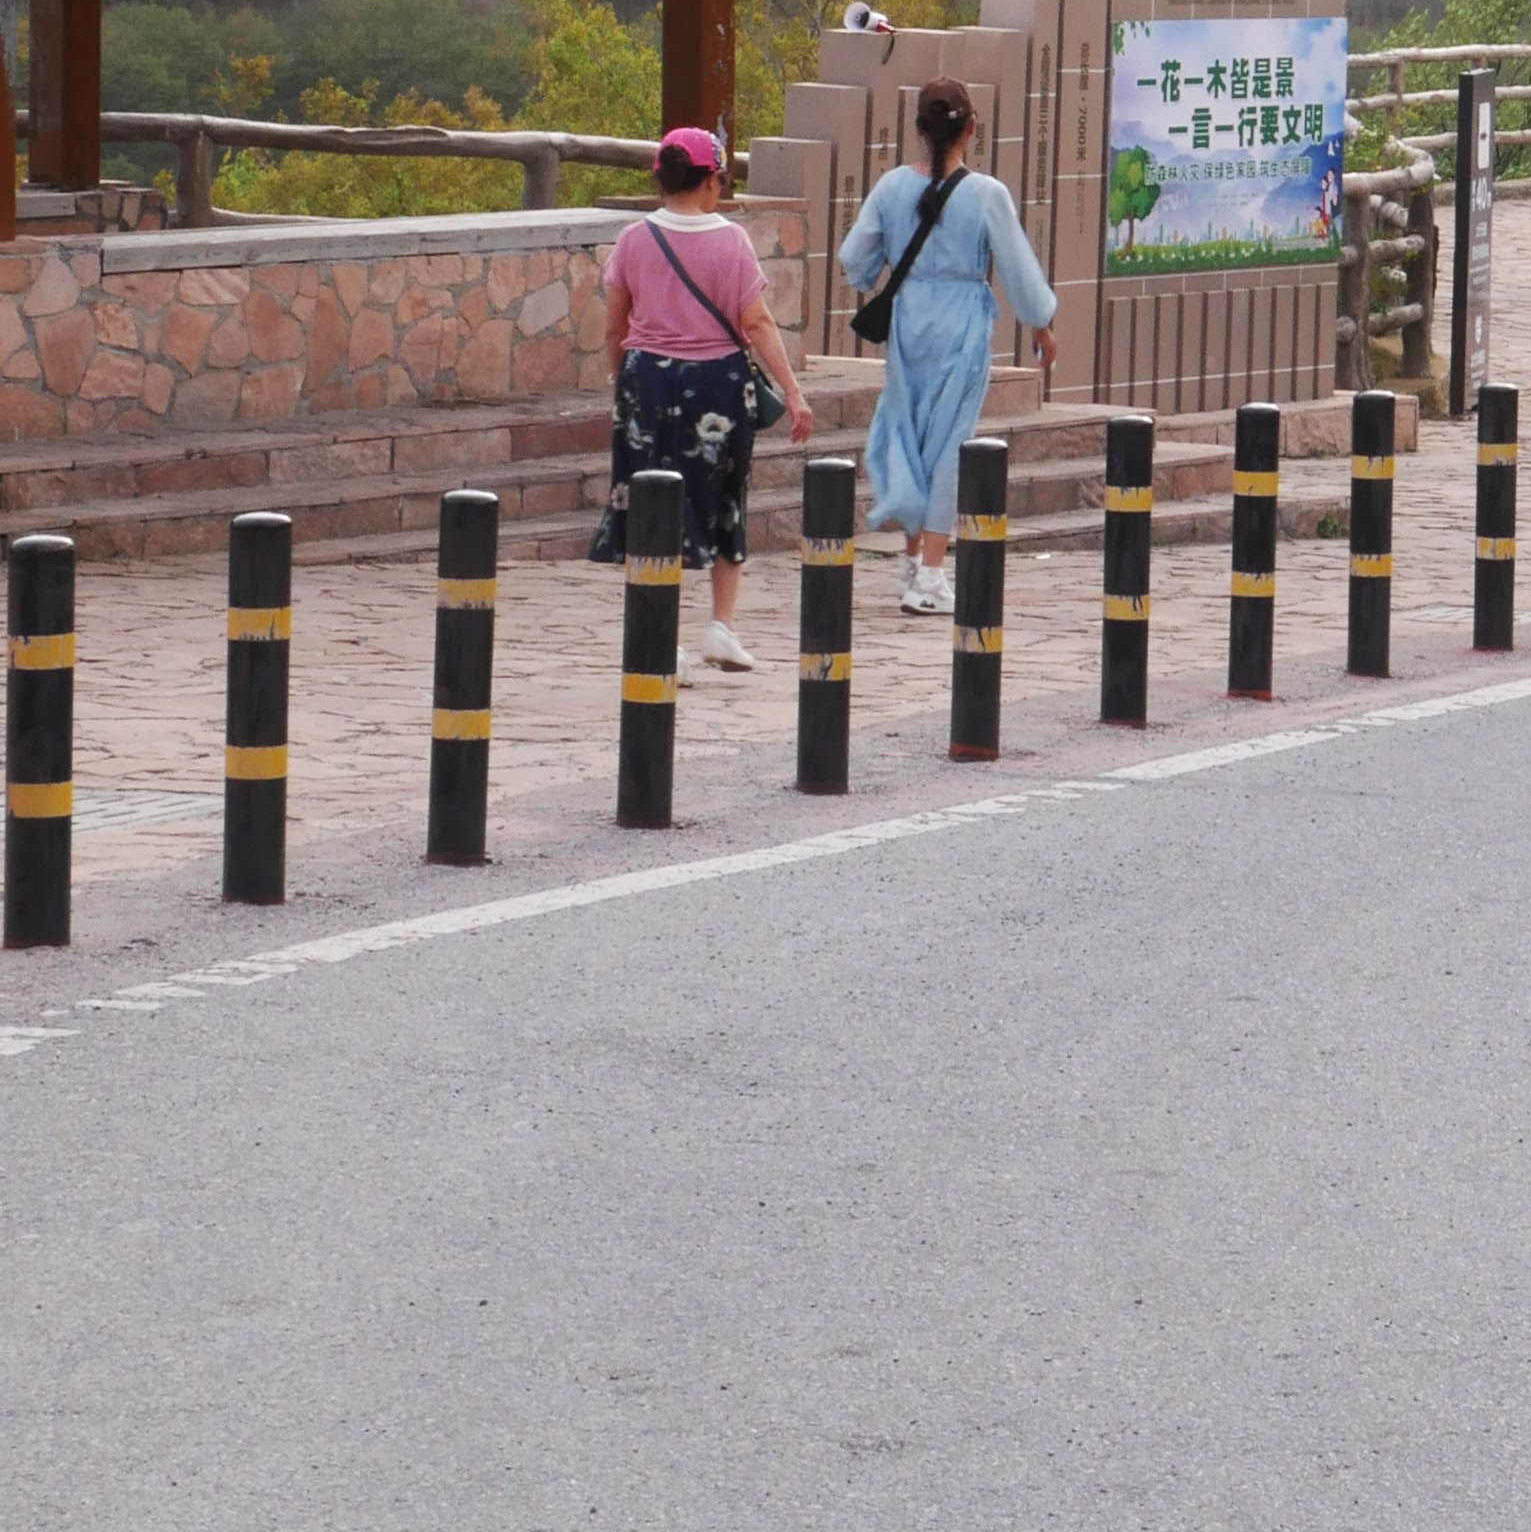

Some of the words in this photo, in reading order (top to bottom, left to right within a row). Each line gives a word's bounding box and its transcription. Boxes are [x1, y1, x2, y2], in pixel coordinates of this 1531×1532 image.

[1136, 57, 1295, 103] 一花一木皆是景
[1168, 104, 1325, 149] 一言一行要文明
